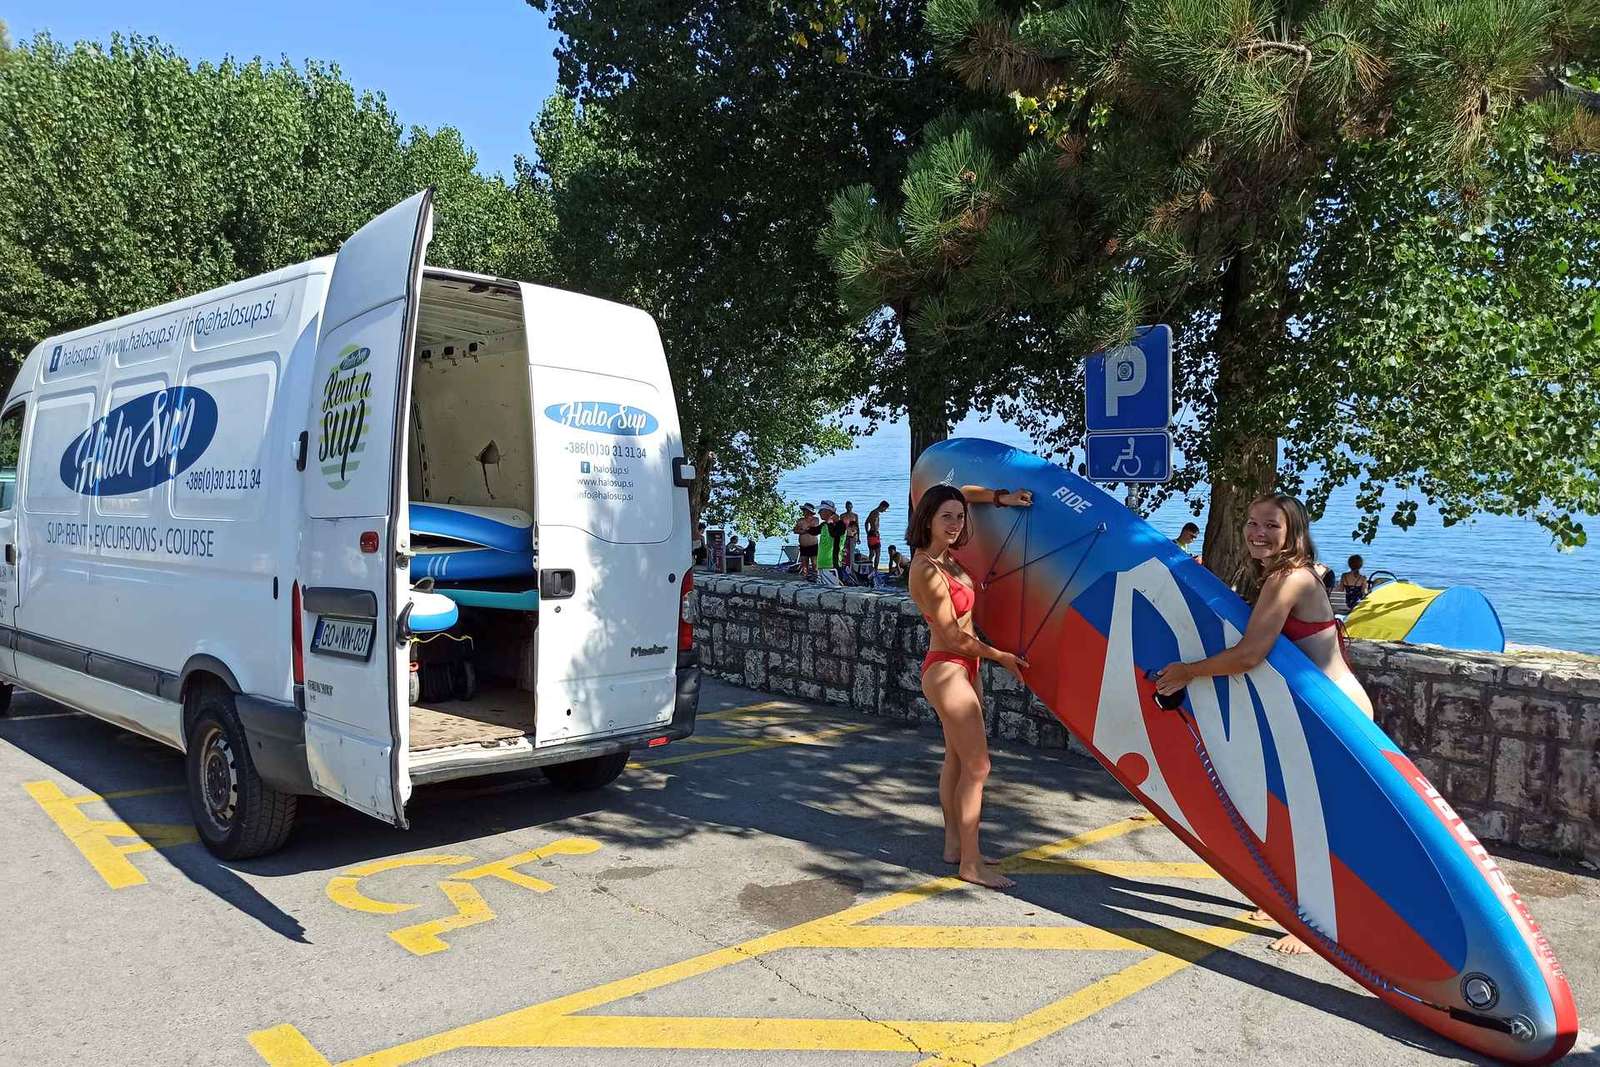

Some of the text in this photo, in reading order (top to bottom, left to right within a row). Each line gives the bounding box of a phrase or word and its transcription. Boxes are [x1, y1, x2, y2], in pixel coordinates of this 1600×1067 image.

[62, 340, 100, 367] halosup.si
[104, 319, 177, 356] www.halosup.si
[184, 293, 277, 337] info@halosup.si
[1105, 345, 1147, 416] P
[560, 401, 647, 437] Halo Sup
[75, 389, 196, 494] Halo Sup
[612, 445, 623, 457] 31
[624, 447, 635, 459] 31
[636, 448, 647, 459] 34
[186, 468, 261, 494] +386(0)30 31 31 34
[593, 464, 629, 475] halosup.si
[577, 478, 634, 489] www.halosup.si
[577, 491, 634, 502] info@halosup.si
[1052, 486, 1093, 513] RIDE
[65, 523, 88, 547] RENT
[94, 525, 157, 552] EXCURSIONS
[165, 528, 215, 558] COURSE
[321, 623, 336, 647] GO
